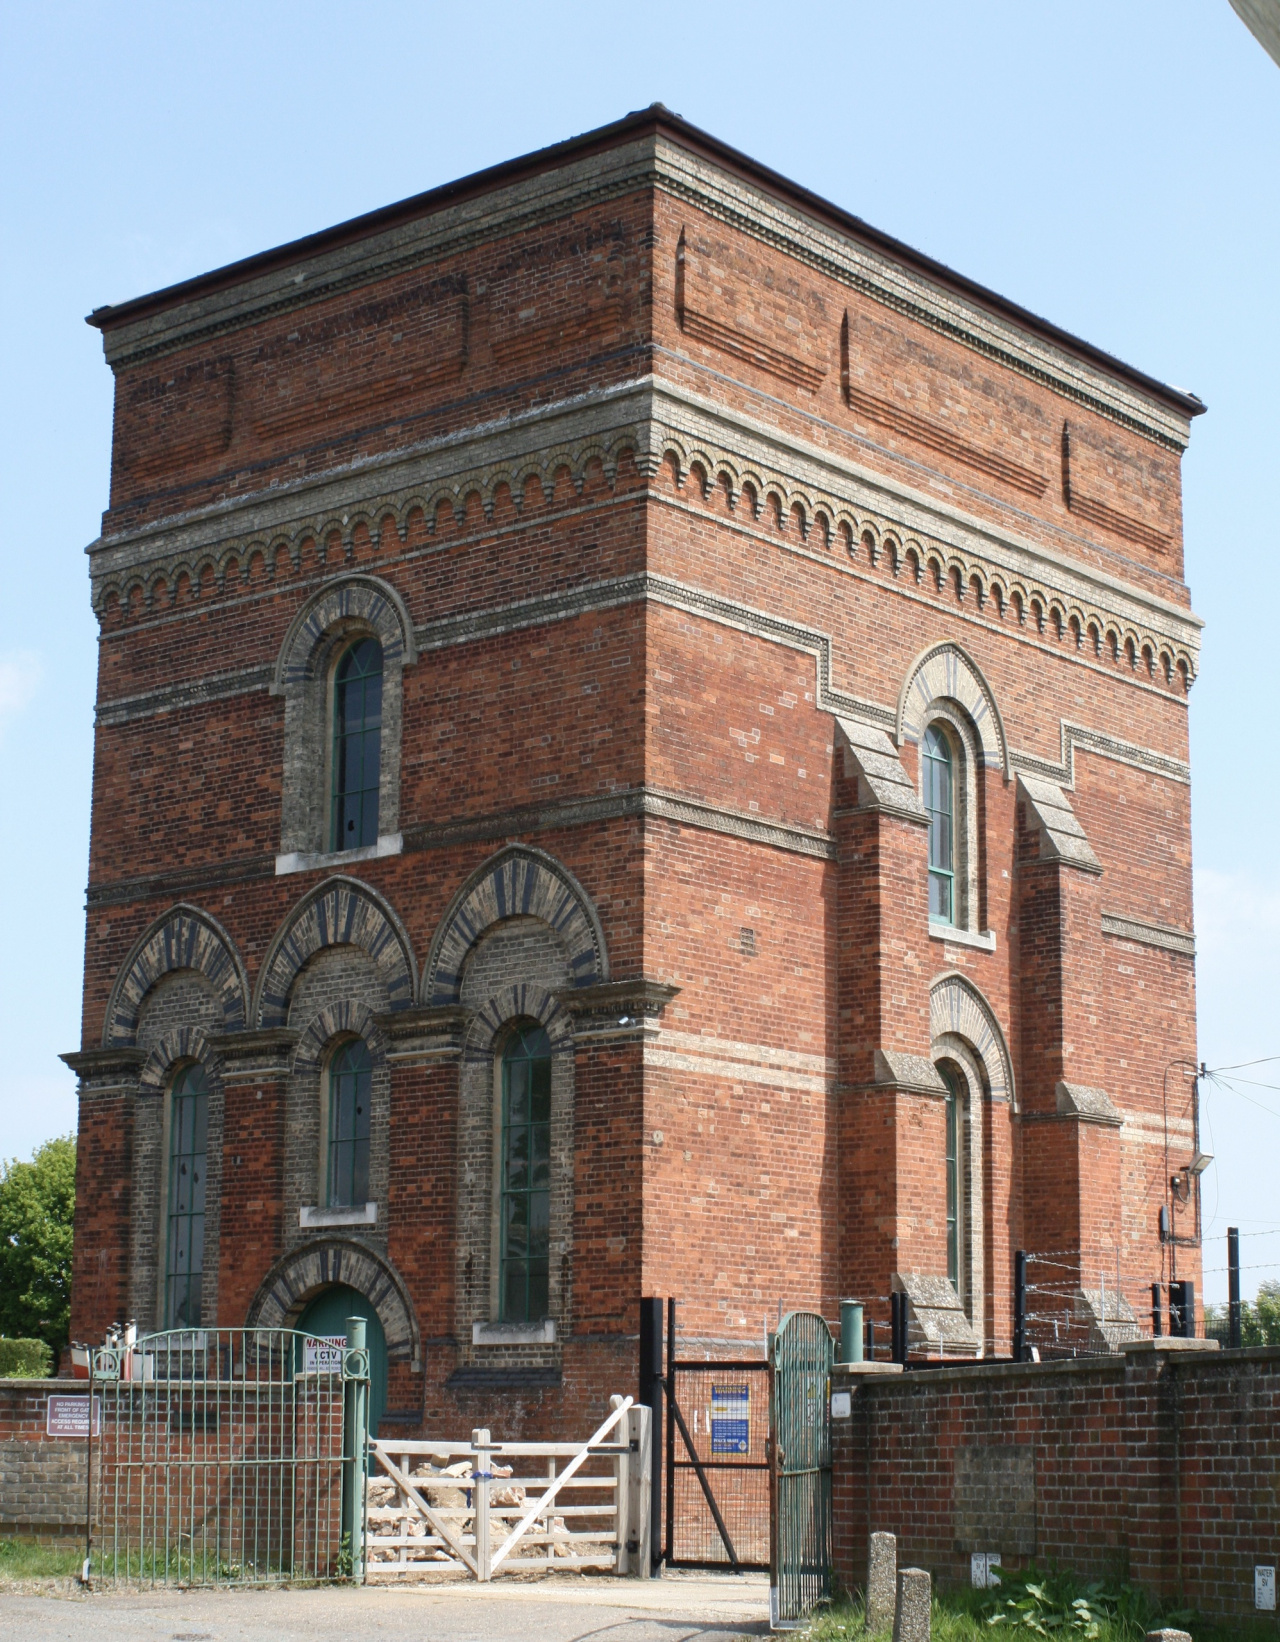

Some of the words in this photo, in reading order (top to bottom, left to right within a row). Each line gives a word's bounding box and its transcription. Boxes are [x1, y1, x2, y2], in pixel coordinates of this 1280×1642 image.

[314, 1351, 337, 1360] CCTV
[714, 1386, 746, 1394] WARNING
[1257, 1568, 1273, 1577] WATER
[1261, 1578, 1268, 1586] SV
